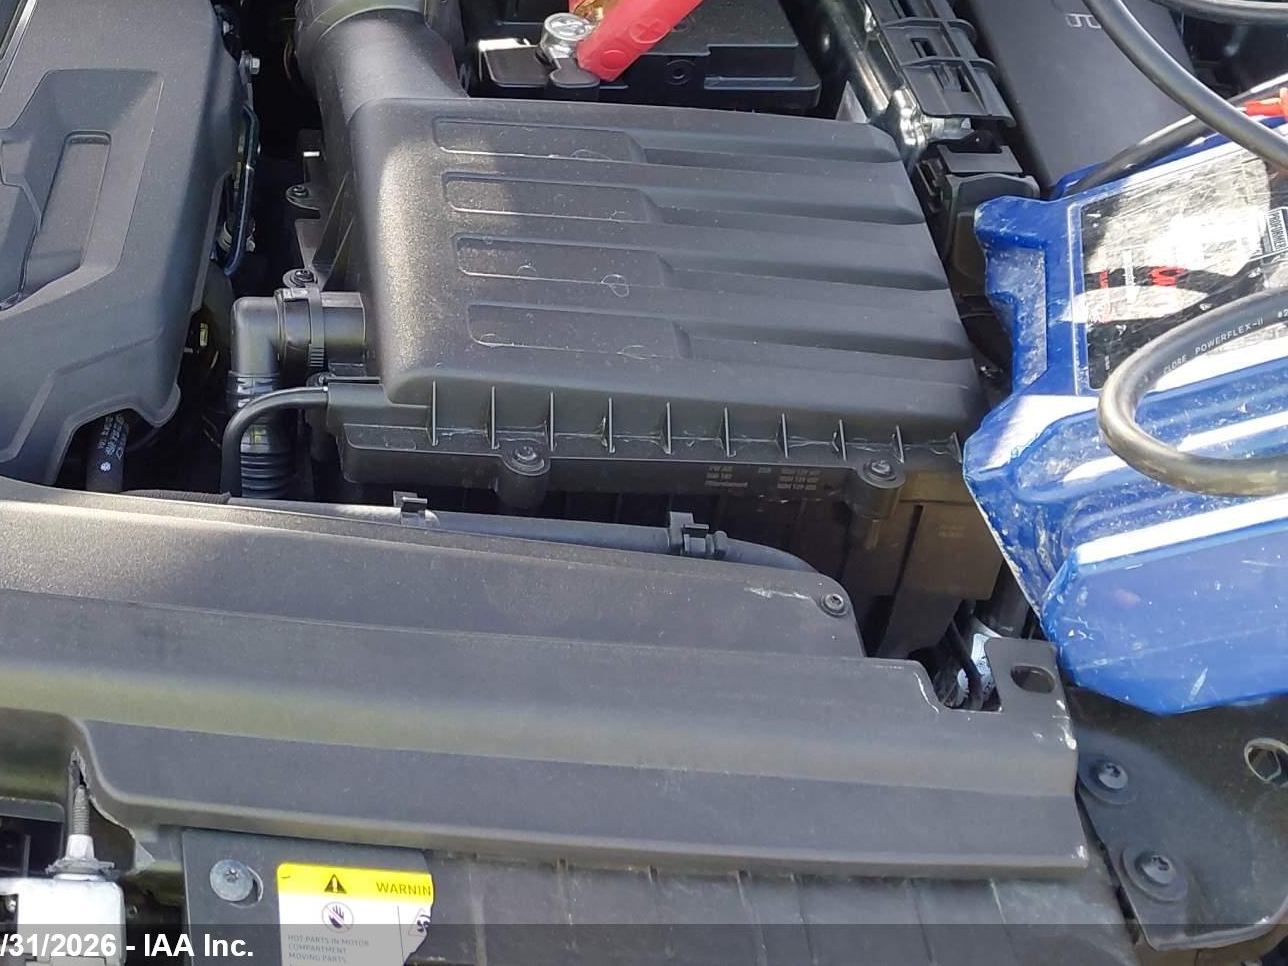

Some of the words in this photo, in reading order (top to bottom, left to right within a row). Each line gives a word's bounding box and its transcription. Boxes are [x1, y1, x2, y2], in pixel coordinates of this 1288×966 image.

[1163, 354, 1188, 375] CLORE
[288, 935, 305, 943] HOT
[306, 935, 331, 944] PARTS
[332, 937, 340, 945] IN
[342, 937, 370, 946] MOTOR
[289, 944, 347, 954] COMPARTMENT
[289, 952, 322, 961] MOVING
[322, 953, 347, 963] PARTS
